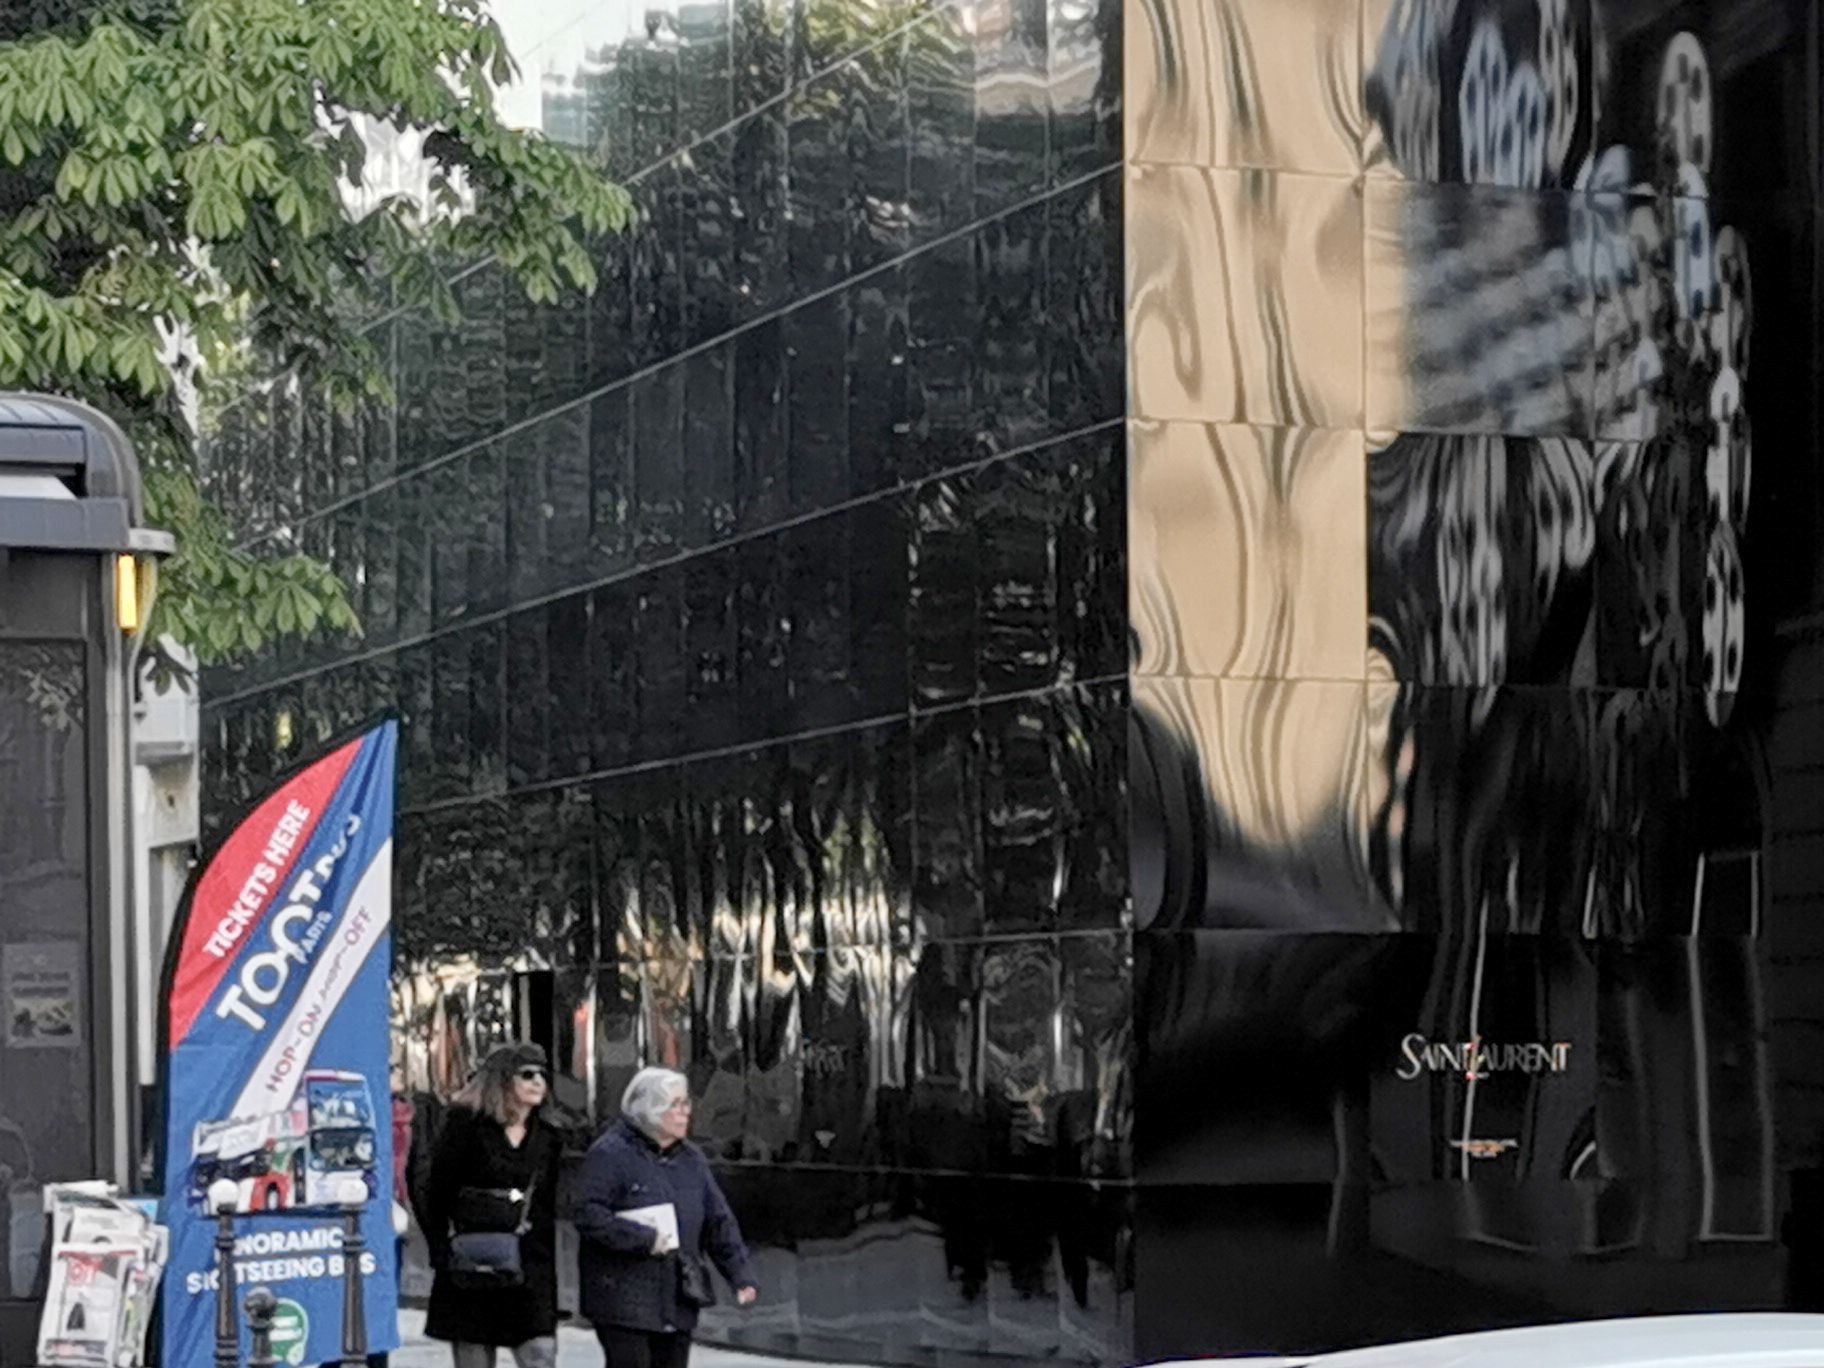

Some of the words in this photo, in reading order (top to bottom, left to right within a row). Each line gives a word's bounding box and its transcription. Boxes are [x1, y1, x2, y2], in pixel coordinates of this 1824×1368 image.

[203, 861, 278, 958] TICKETS
[262, 798, 311, 867] HERE
[214, 1227, 345, 1264] NORAMIC
[186, 1256, 326, 1294] SIGTSEEING
[329, 1251, 376, 1276] BS
